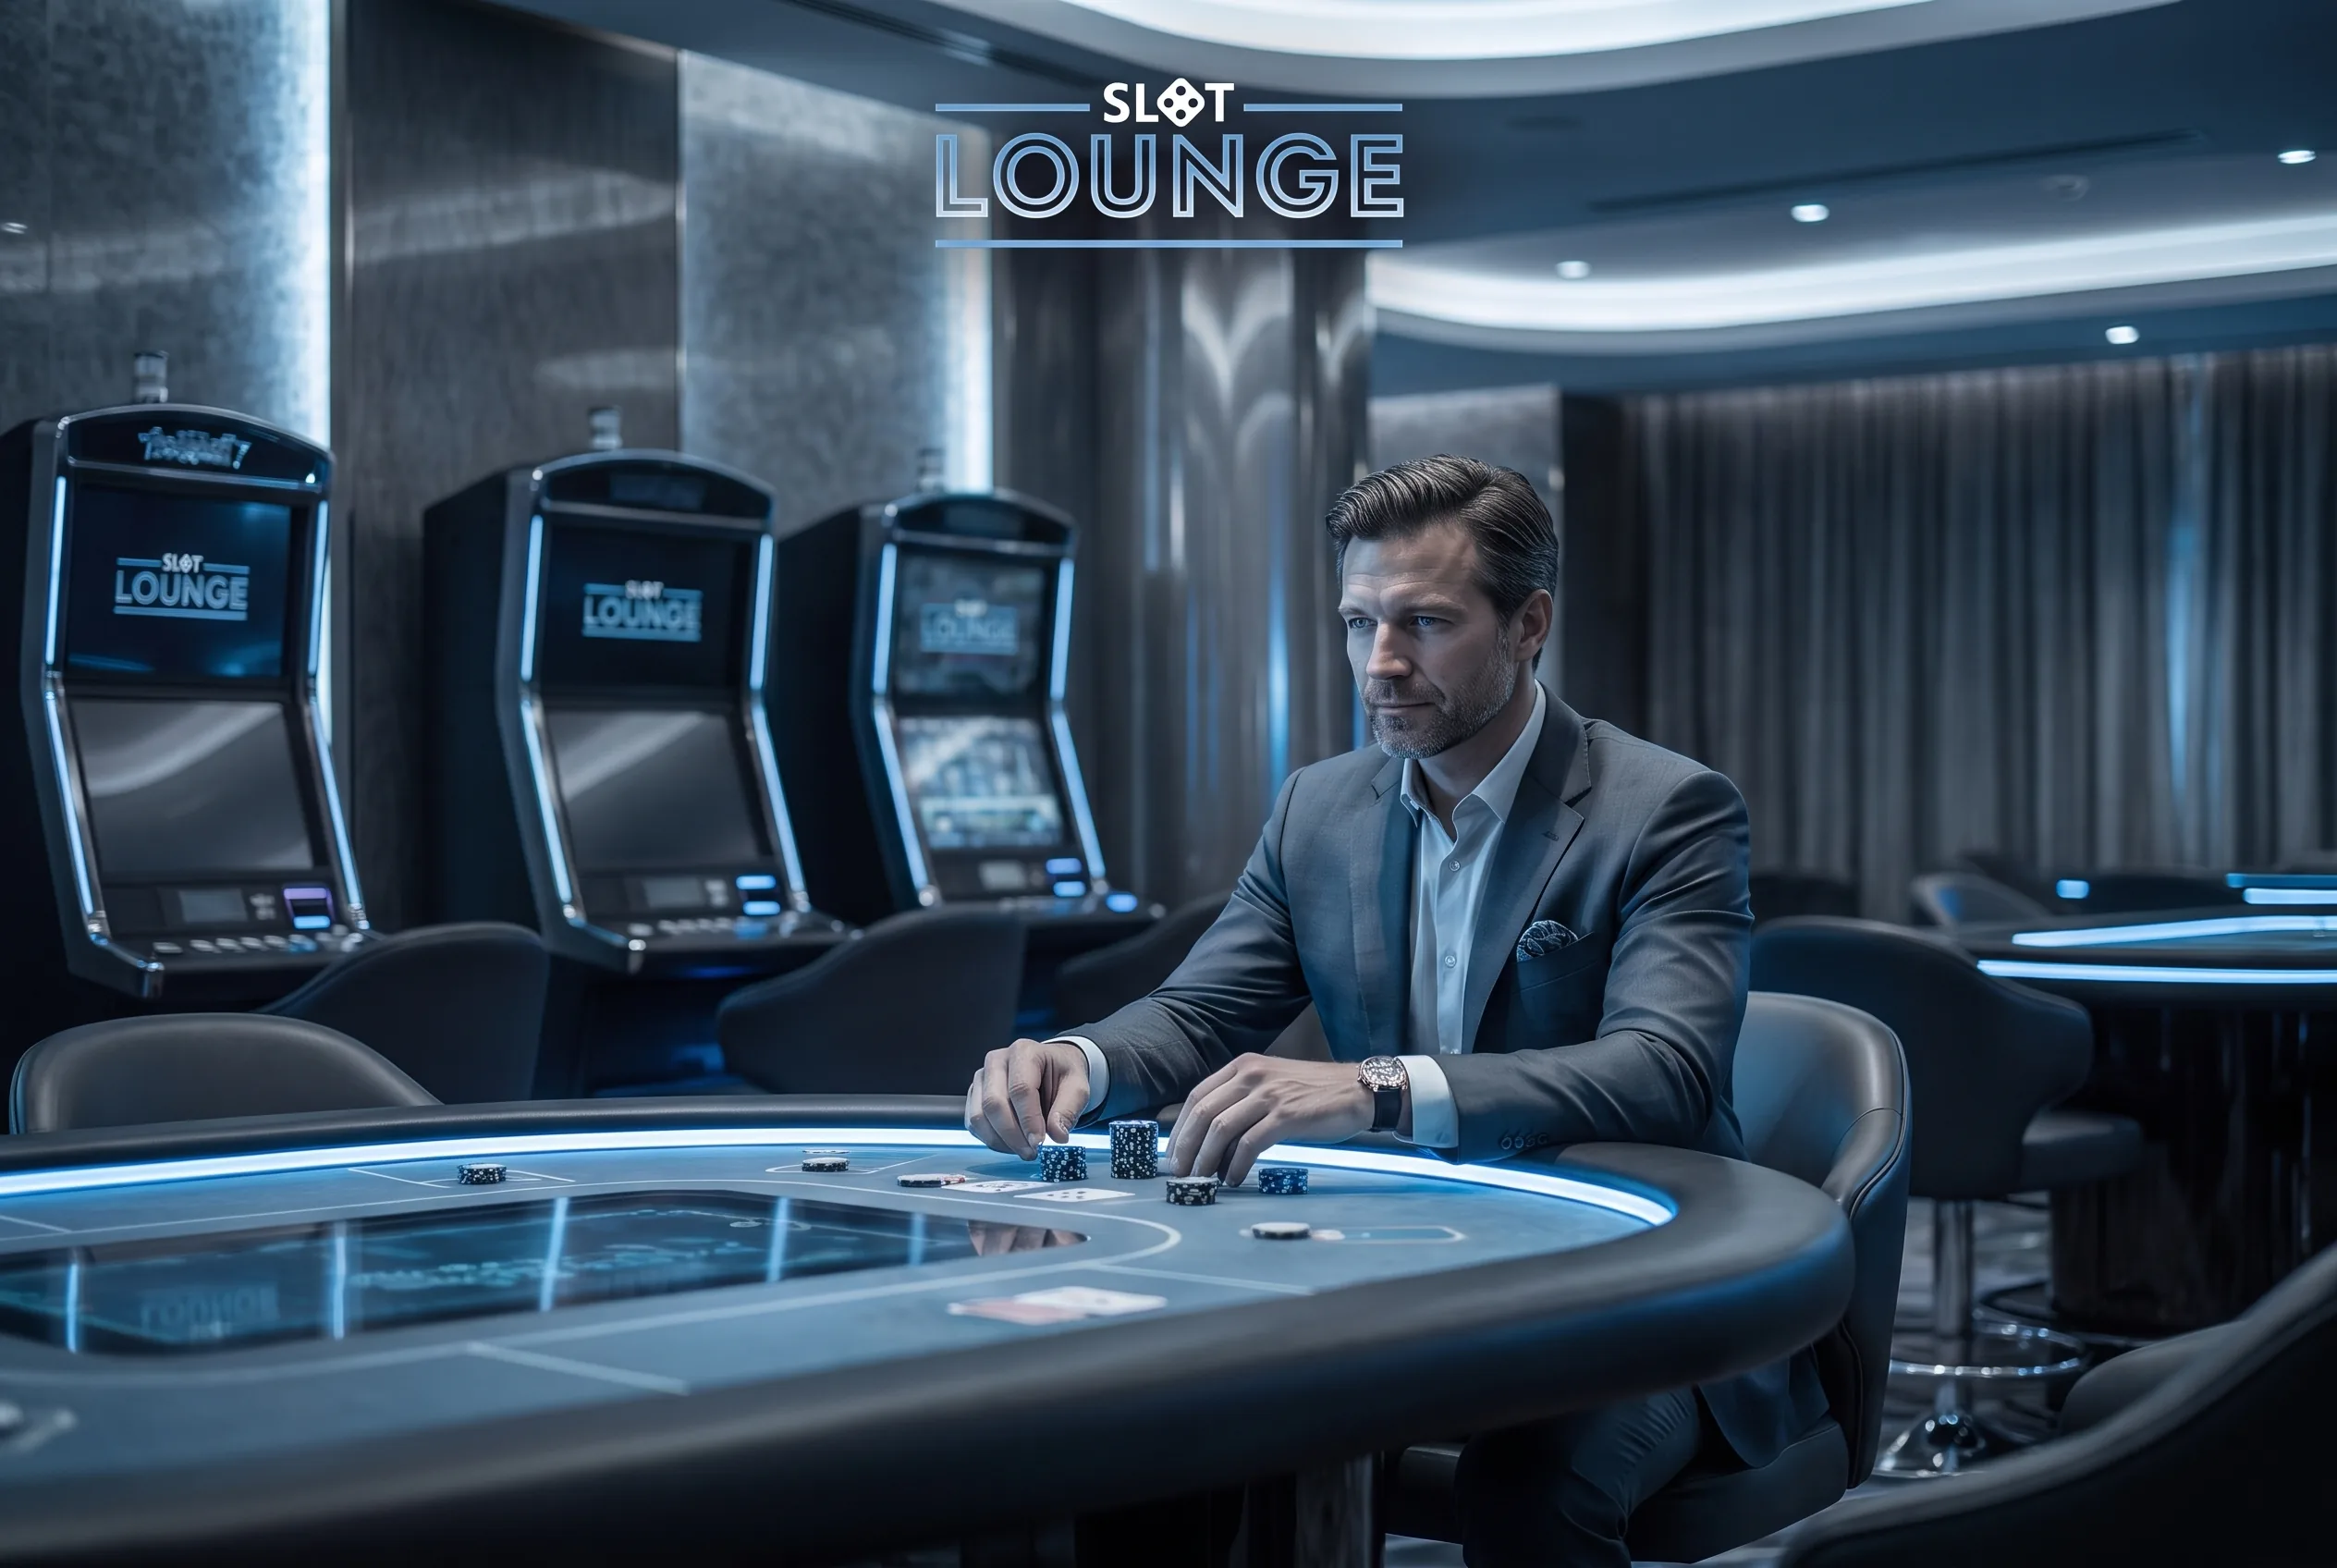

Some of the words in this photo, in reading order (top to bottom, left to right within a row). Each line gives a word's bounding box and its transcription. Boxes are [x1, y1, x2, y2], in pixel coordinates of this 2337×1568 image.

[162, 553, 204, 573] SLOT
[116, 570, 249, 610] LOUNGE
[583, 596, 702, 631] LOUNGE
